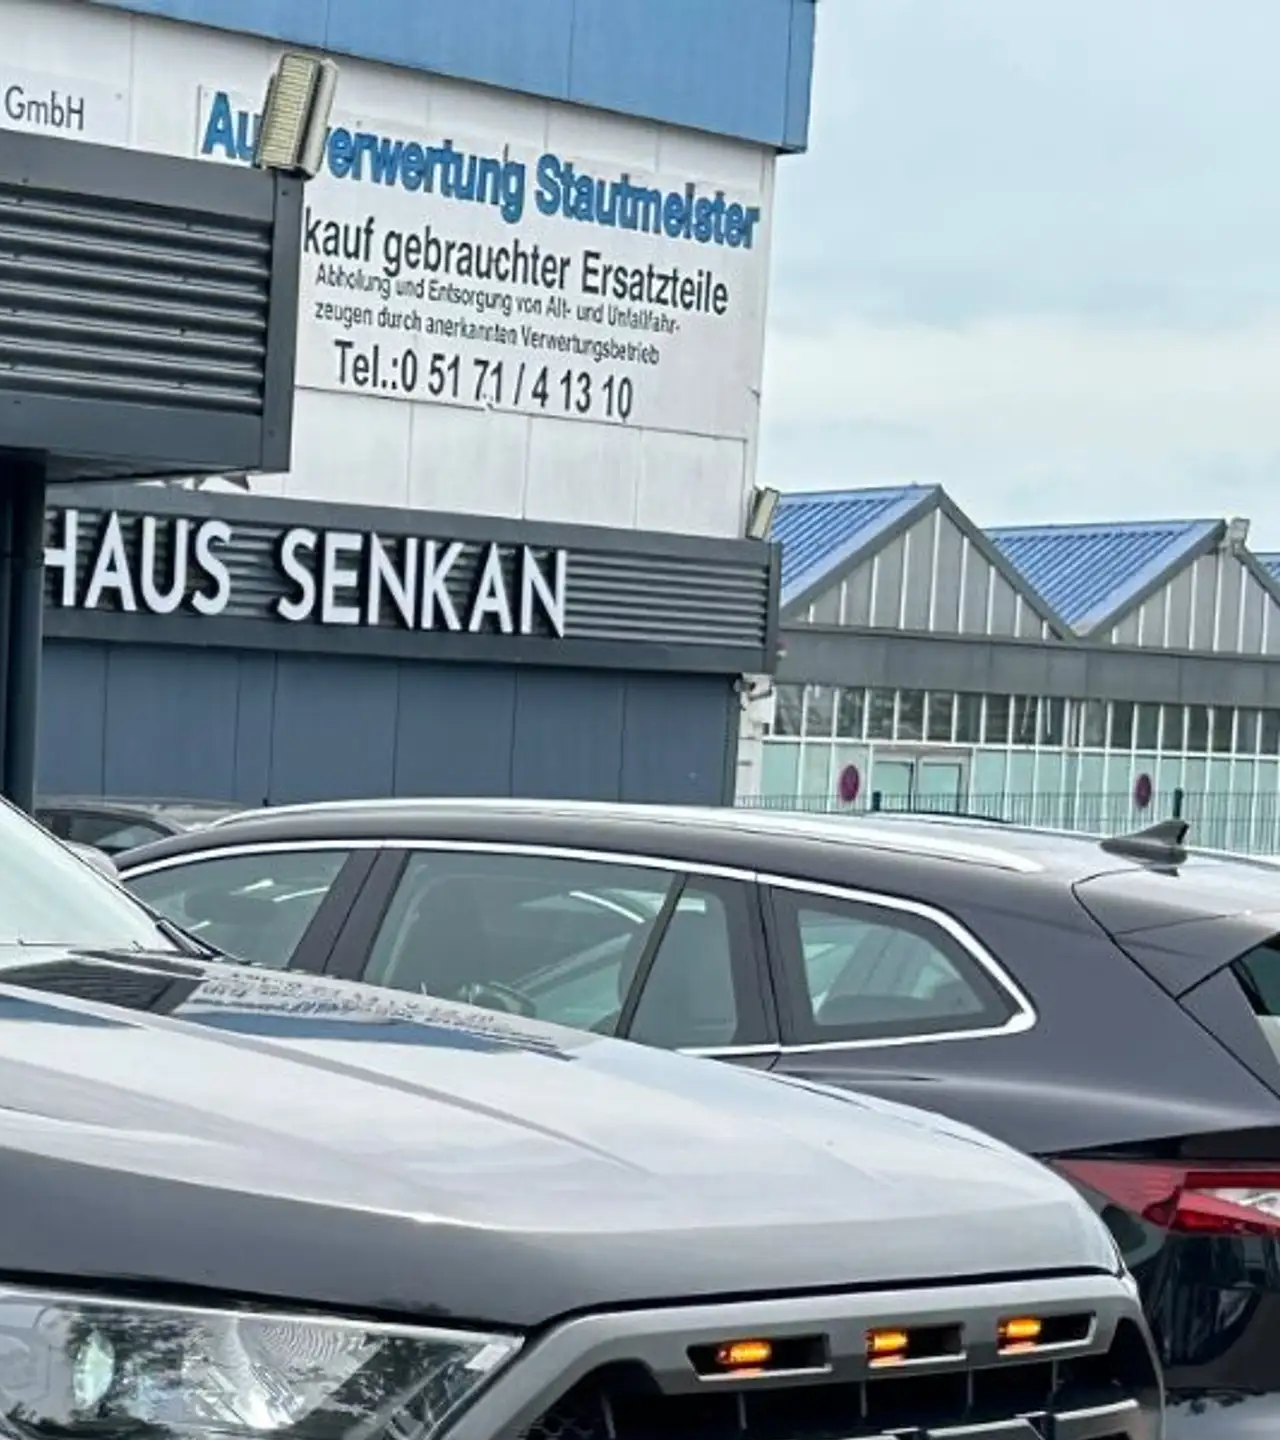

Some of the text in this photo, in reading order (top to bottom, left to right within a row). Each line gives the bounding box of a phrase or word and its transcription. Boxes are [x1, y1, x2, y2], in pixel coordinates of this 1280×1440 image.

[4, 84, 85, 132] GmbH
[200, 90, 760, 250] Auerwertung Stautmeister
[303, 206, 729, 316] kauf gebrauchter Ersatzteile
[315, 261, 391, 301] Abholung
[395, 277, 425, 300] und
[428, 279, 512, 317] Entsorgung
[516, 296, 541, 315] von
[546, 295, 571, 319] Alt-
[576, 302, 604, 325] und
[315, 300, 660, 366] zeugen durch anerkannten Verwertungsbetrieb
[428, 353, 462, 399] 51
[473, 358, 504, 405] 71
[513, 362, 526, 407] /
[531, 365, 549, 410] 4
[560, 368, 592, 414] 13
[602, 374, 633, 421] 10
[276, 527, 566, 638] SENKAN
